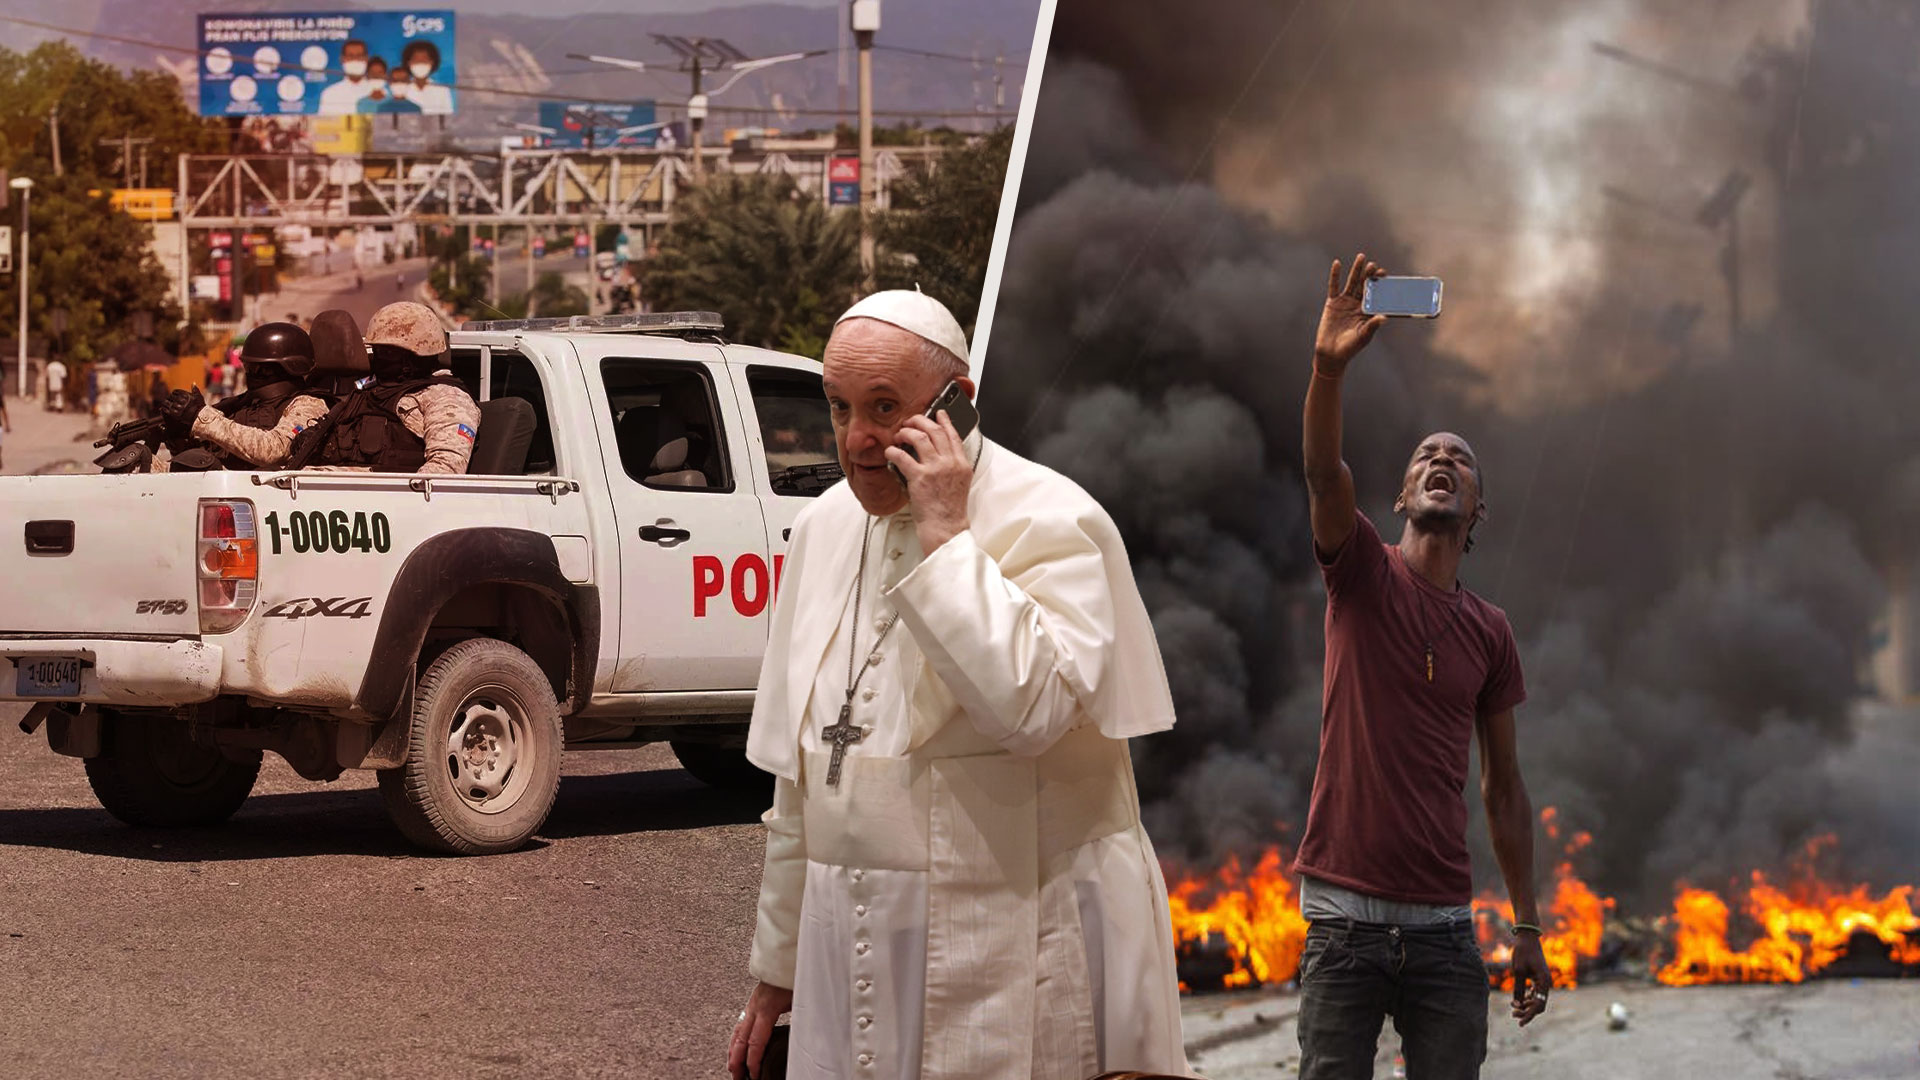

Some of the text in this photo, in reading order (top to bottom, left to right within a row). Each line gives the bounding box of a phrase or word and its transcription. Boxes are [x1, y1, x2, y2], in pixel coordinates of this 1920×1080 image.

[297, 18, 315, 29] LA
[264, 510, 391, 555] 1-00640
[136, 599, 189, 616] BT-50
